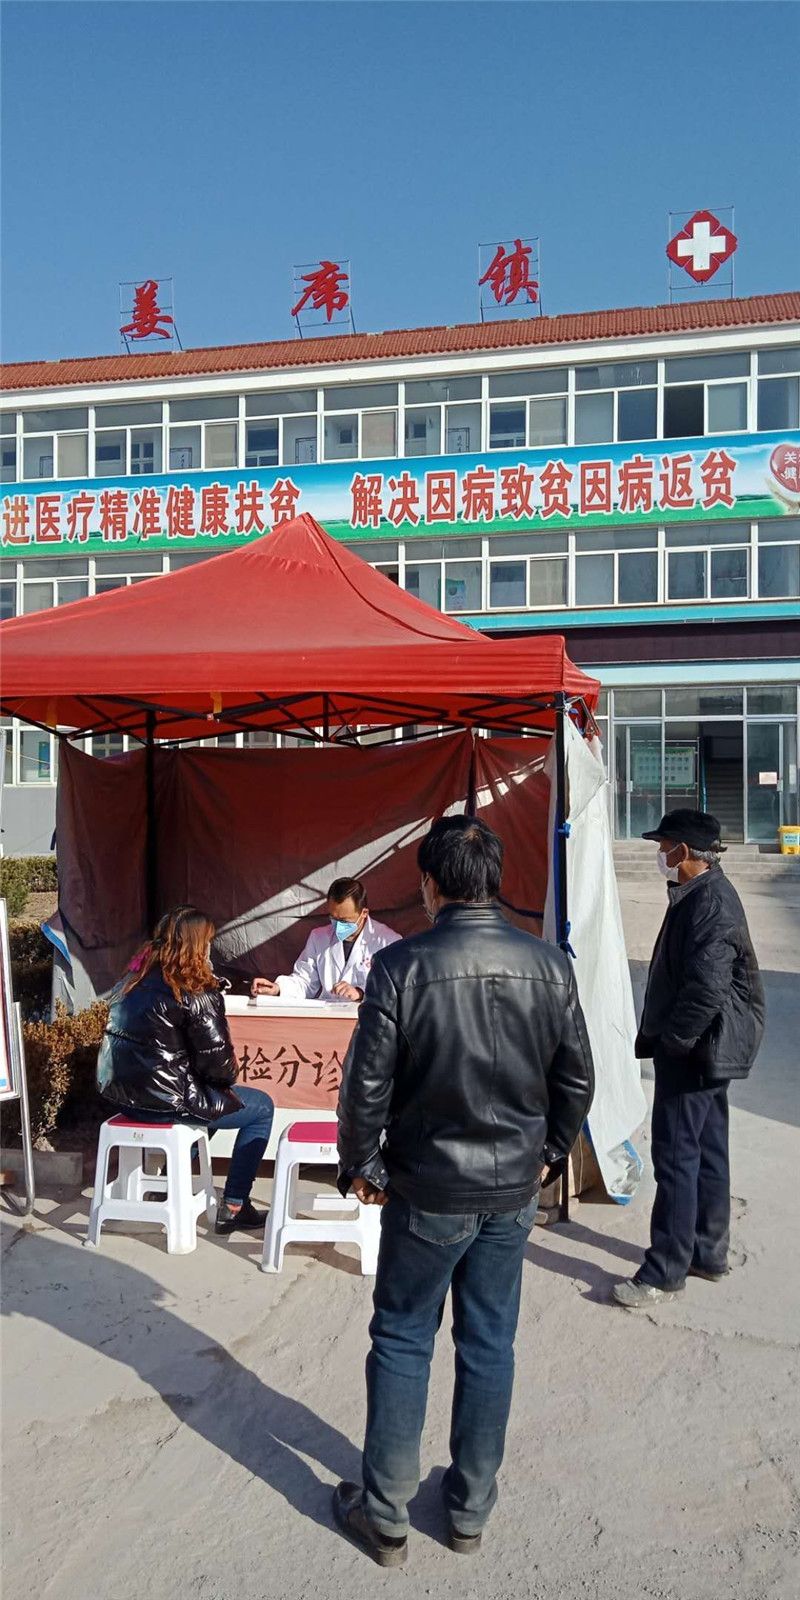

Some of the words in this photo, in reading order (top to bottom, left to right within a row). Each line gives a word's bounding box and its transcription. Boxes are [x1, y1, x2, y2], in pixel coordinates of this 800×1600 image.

[119, 239, 538, 339] 姜席镇
[784, 451, 800, 465] 关
[2, 479, 301, 544] 进医疗精准健康扶贫
[351, 450, 737, 528] 解决因病致贫因病返贫
[238, 1044, 343, 1092] 检分诊
